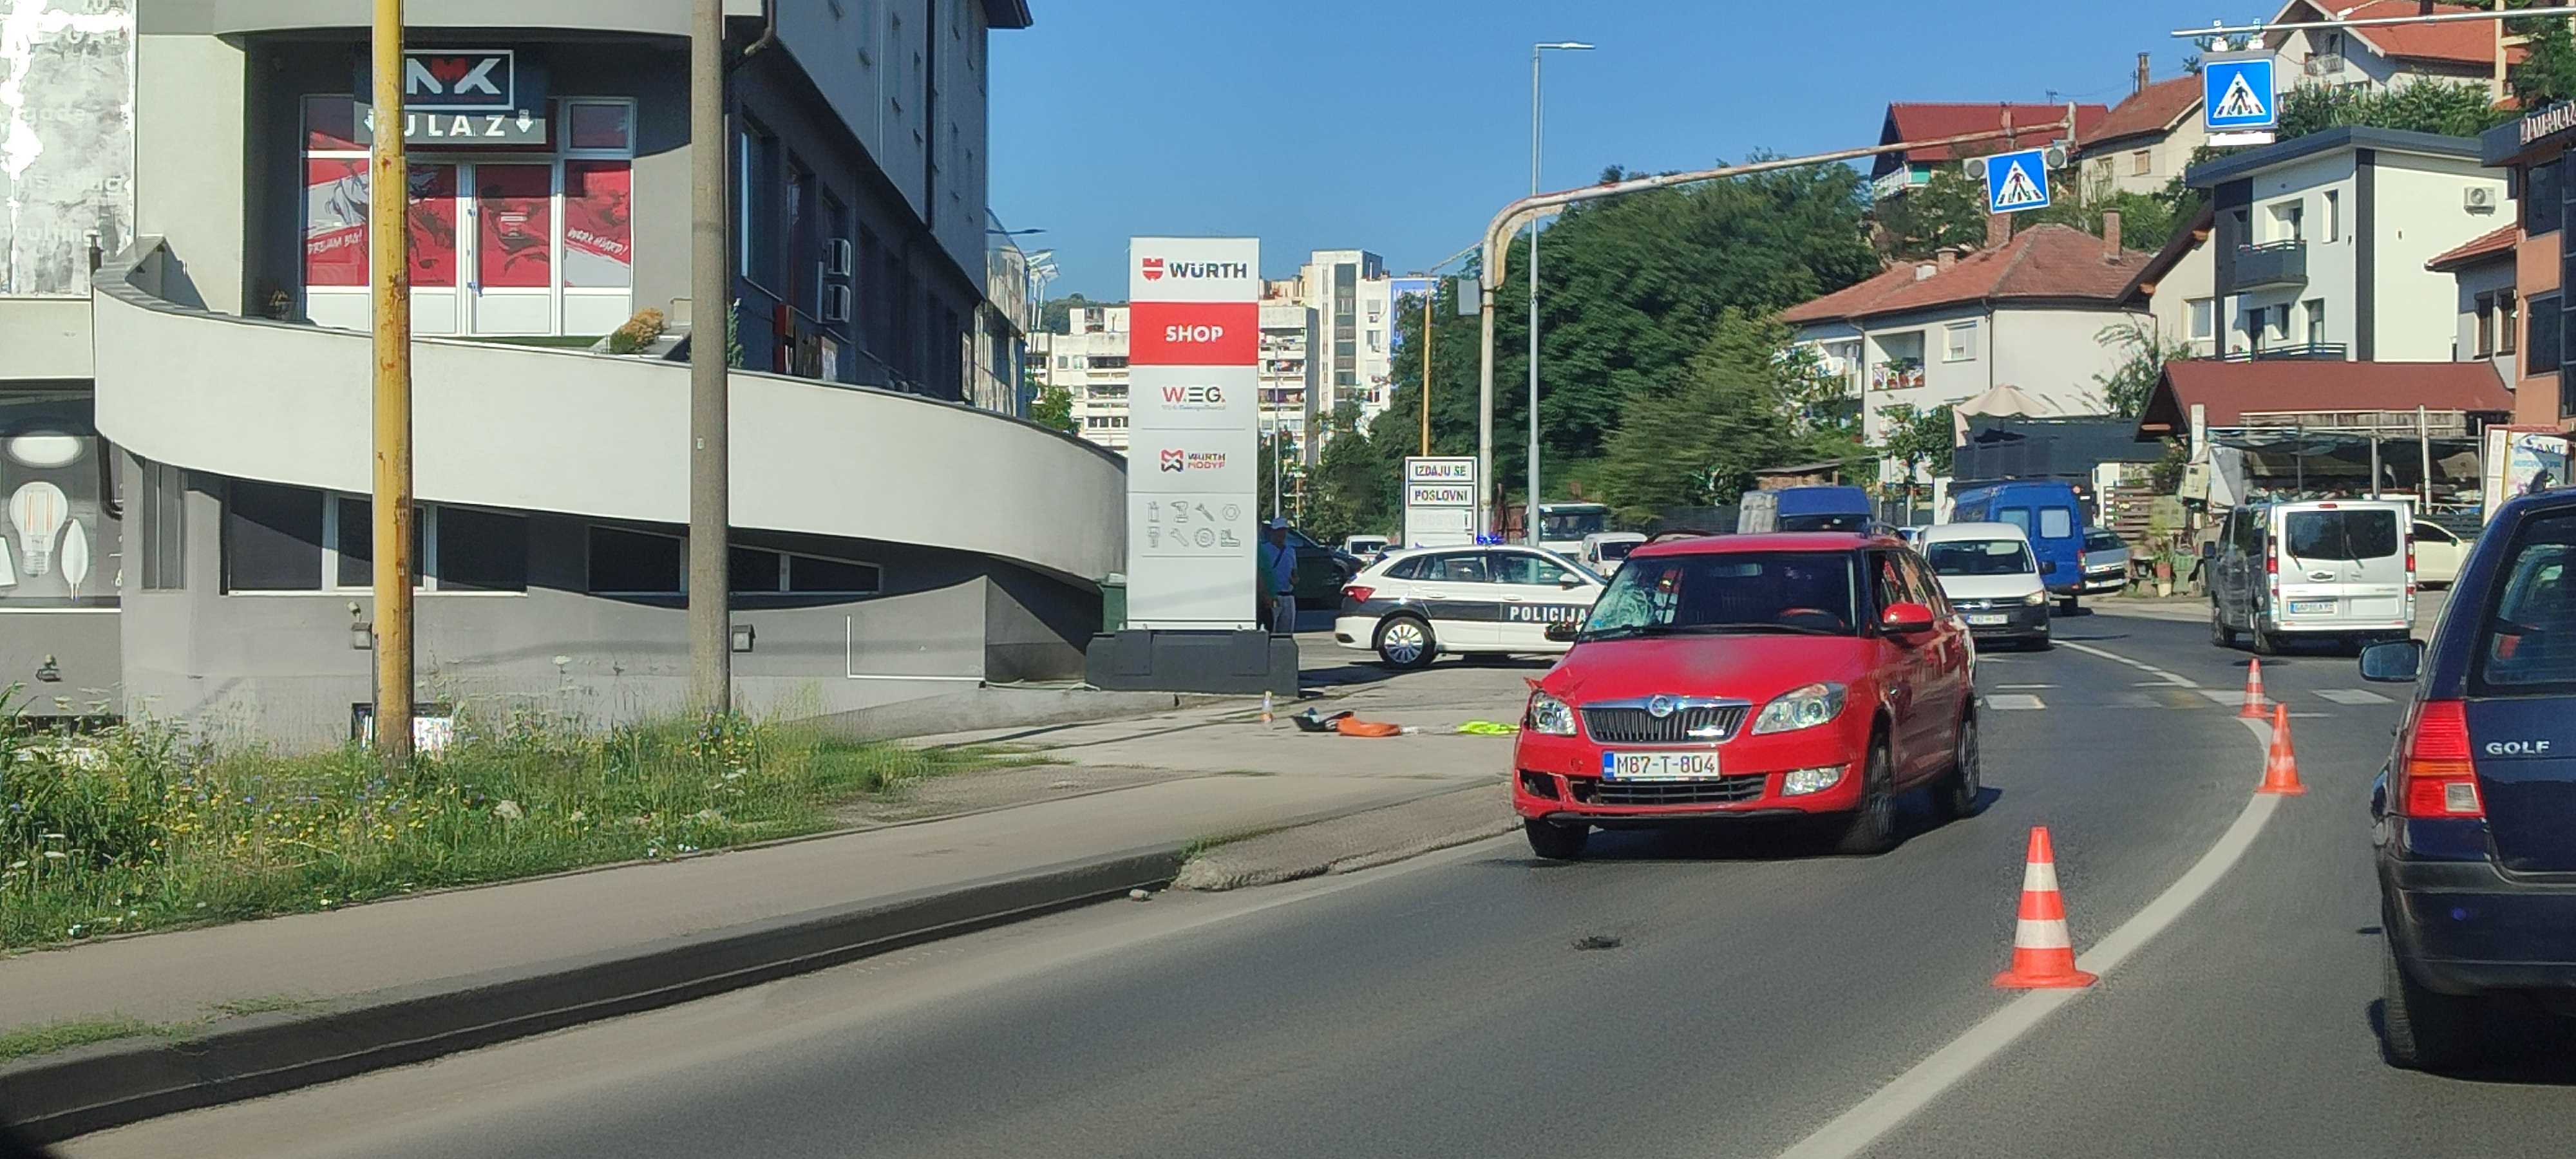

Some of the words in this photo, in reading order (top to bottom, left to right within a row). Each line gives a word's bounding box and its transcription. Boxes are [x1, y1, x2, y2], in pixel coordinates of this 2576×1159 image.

[1170, 262, 1247, 278] WÜRTH
[1165, 325, 1223, 342] SHOP
[1416, 466, 1450, 476] IZDAJU
[1454, 466, 1466, 476] SE
[1415, 490, 1467, 501] POSLOVNI
[1510, 606, 1586, 623] POLICIJA
[2485, 740, 2550, 755] GOLF
[1616, 755, 1715, 775] M87-T-804
